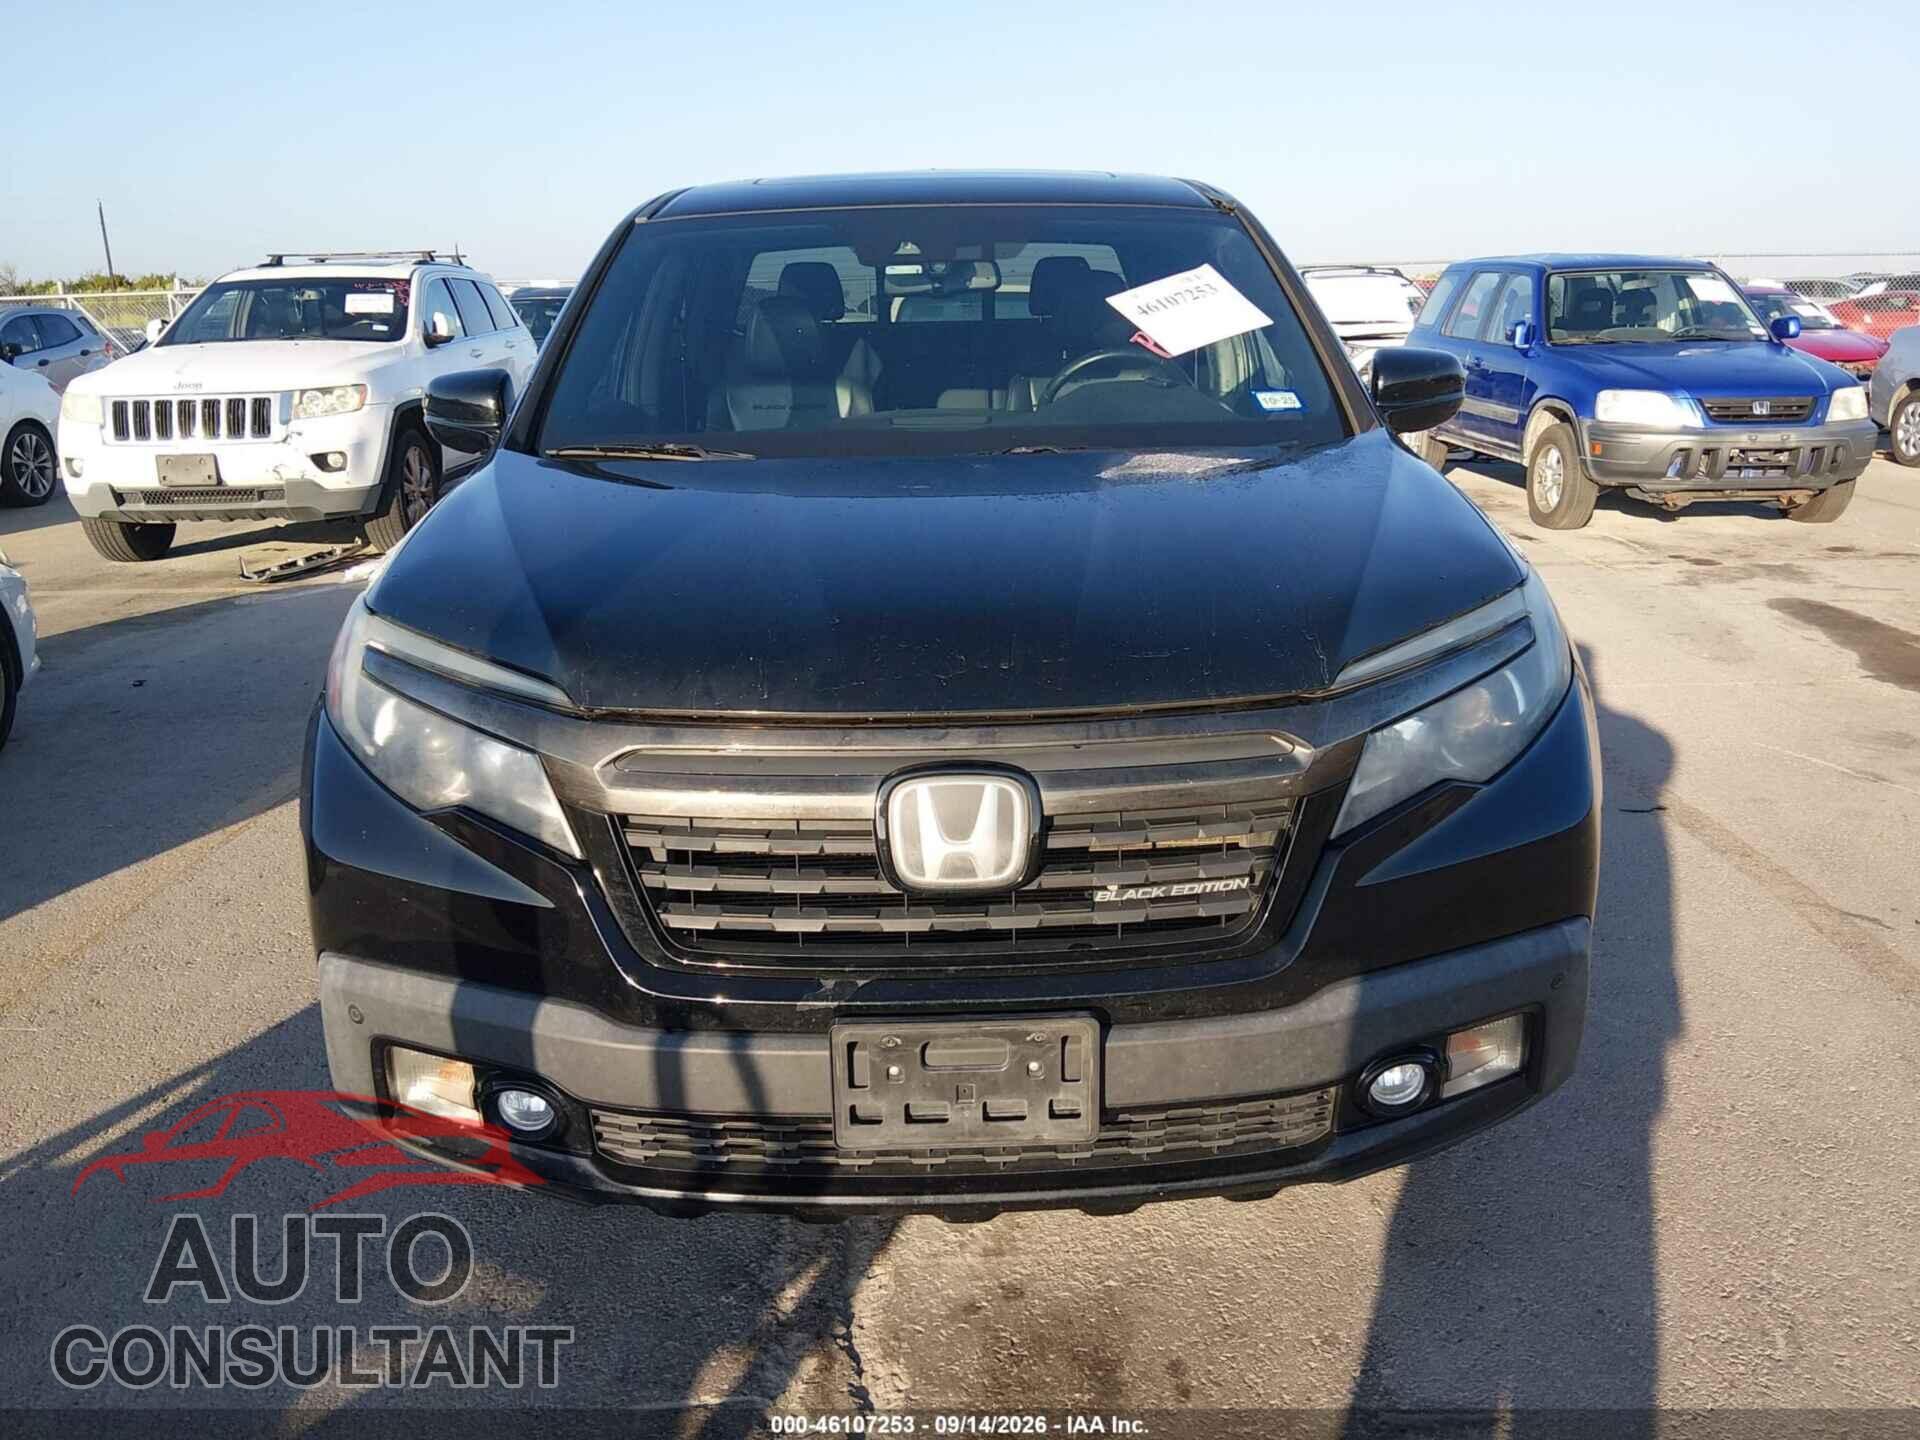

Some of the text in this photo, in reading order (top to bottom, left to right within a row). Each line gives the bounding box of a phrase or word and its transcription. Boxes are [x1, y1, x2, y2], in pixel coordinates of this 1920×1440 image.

[1136, 282, 1219, 316] 46107253
[1094, 877, 1250, 902] BLACK EDITION
